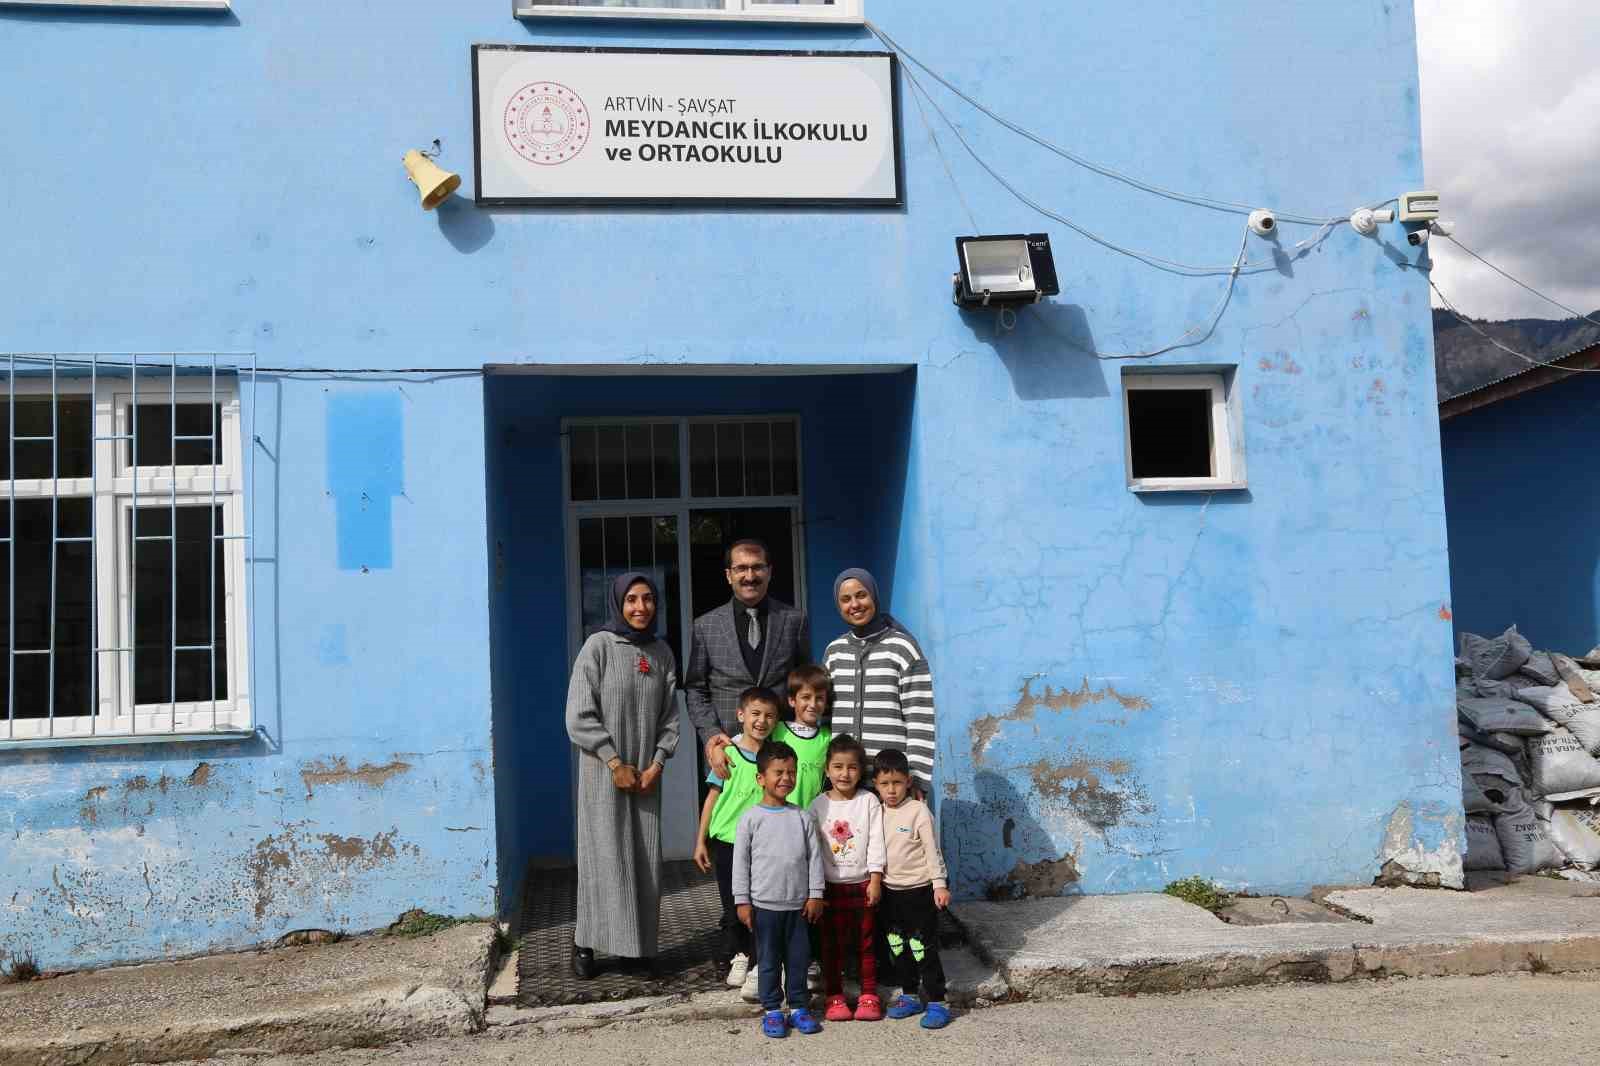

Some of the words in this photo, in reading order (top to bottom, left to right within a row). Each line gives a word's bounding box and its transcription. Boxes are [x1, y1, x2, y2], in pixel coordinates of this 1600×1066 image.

[604, 94, 663, 112] ARTVİN
[678, 97, 736, 116] ŞAVŞAT
[605, 119, 747, 139] MEYDANCIK
[753, 118, 867, 141] İLKOKULU
[605, 147, 632, 161] ve
[638, 144, 781, 163] ORTAOKULU
